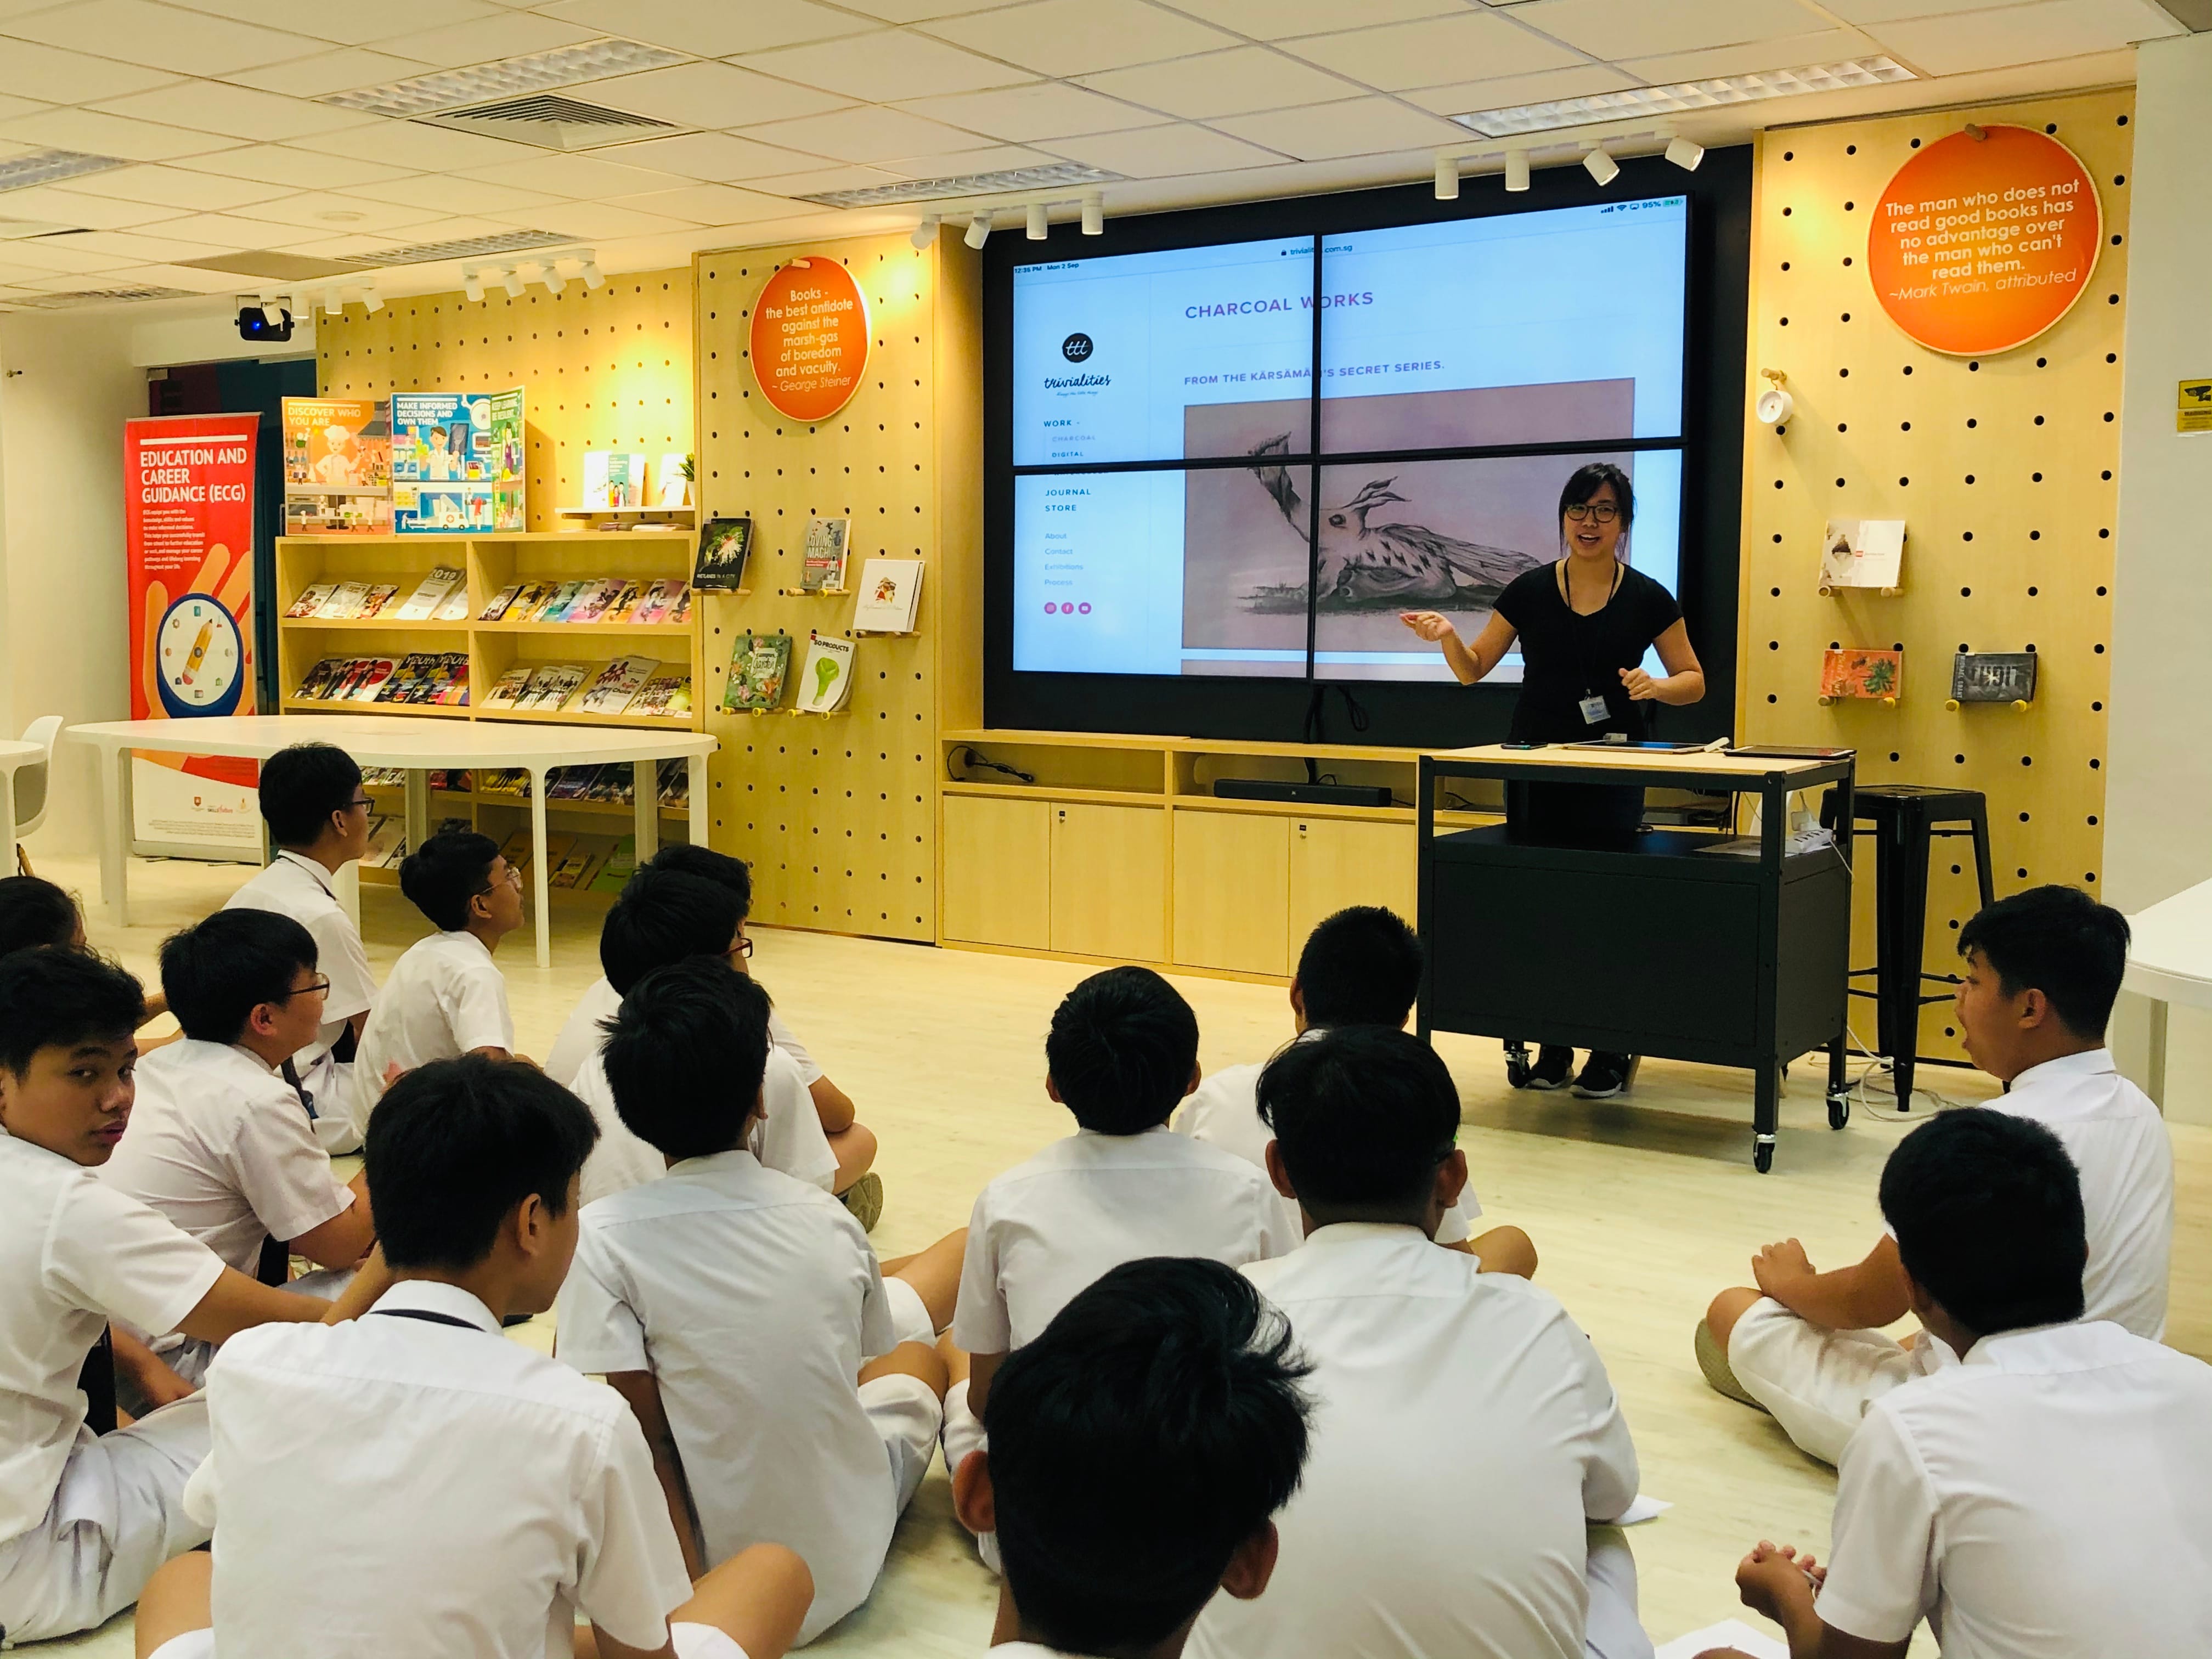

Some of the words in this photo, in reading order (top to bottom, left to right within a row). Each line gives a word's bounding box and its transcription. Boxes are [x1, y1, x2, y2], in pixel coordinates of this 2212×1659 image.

[1886, 203, 1914, 217] The
[1920, 196, 1957, 212] man
[1962, 191, 1997, 206] who
[2004, 187, 2045, 202] does
[2051, 179, 2079, 195] not
[1891, 217, 1929, 233] read
[1936, 210, 1980, 231] good
[1986, 204, 2038, 222] books
[2044, 200, 2074, 215] has
[1900, 235, 1921, 249] no
[1926, 222, 2020, 246] advantage
[2026, 219, 2064, 234] over
[1903, 251, 1929, 266] the
[1934, 246, 1971, 262] man
[1977, 242, 2013, 258] who
[2018, 234, 2062, 252] can't
[1932, 263, 1971, 279] read
[1977, 259, 2025, 274] them.
[1943, 280, 1989, 296] Twain,
[1996, 269, 2076, 291] attributed
[790, 288, 821, 302] Books
[766, 307, 783, 319] the
[786, 304, 808, 317] best
[811, 298, 853, 315] antidote
[1185, 298, 1293, 319] CHARCOAL
[1300, 292, 1374, 309] WORKS
[782, 318, 820, 334] against
[823, 316, 839, 328] the
[783, 332, 838, 347] marsh-gas
[781, 351, 791, 362] of
[793, 347, 842, 361] boredom
[776, 364, 797, 377] and
[800, 360, 840, 375] vacuity.
[1184, 375, 1218, 385] FROM
[1223, 373, 1246, 383] THE
[1250, 366, 1335, 381] KÄRSÄMÄ'S
[1339, 364, 1390, 377] SECRET
[1394, 361, 1445, 373] SERIES.
[780, 380, 817, 392] George
[820, 376, 851, 387] Steiner
[1044, 373, 1111, 389] trivialities
[288, 407, 335, 416] DISCOVER
[337, 408, 360, 417] WHO
[140, 449, 213, 467] EDUCATION
[217, 448, 247, 464] AND
[142, 468, 190, 485] CAREER
[142, 486, 206, 503] GUIDANCE
[209, 483, 246, 503] (ECG)
[822, 641, 849, 652] PRODUCTS
